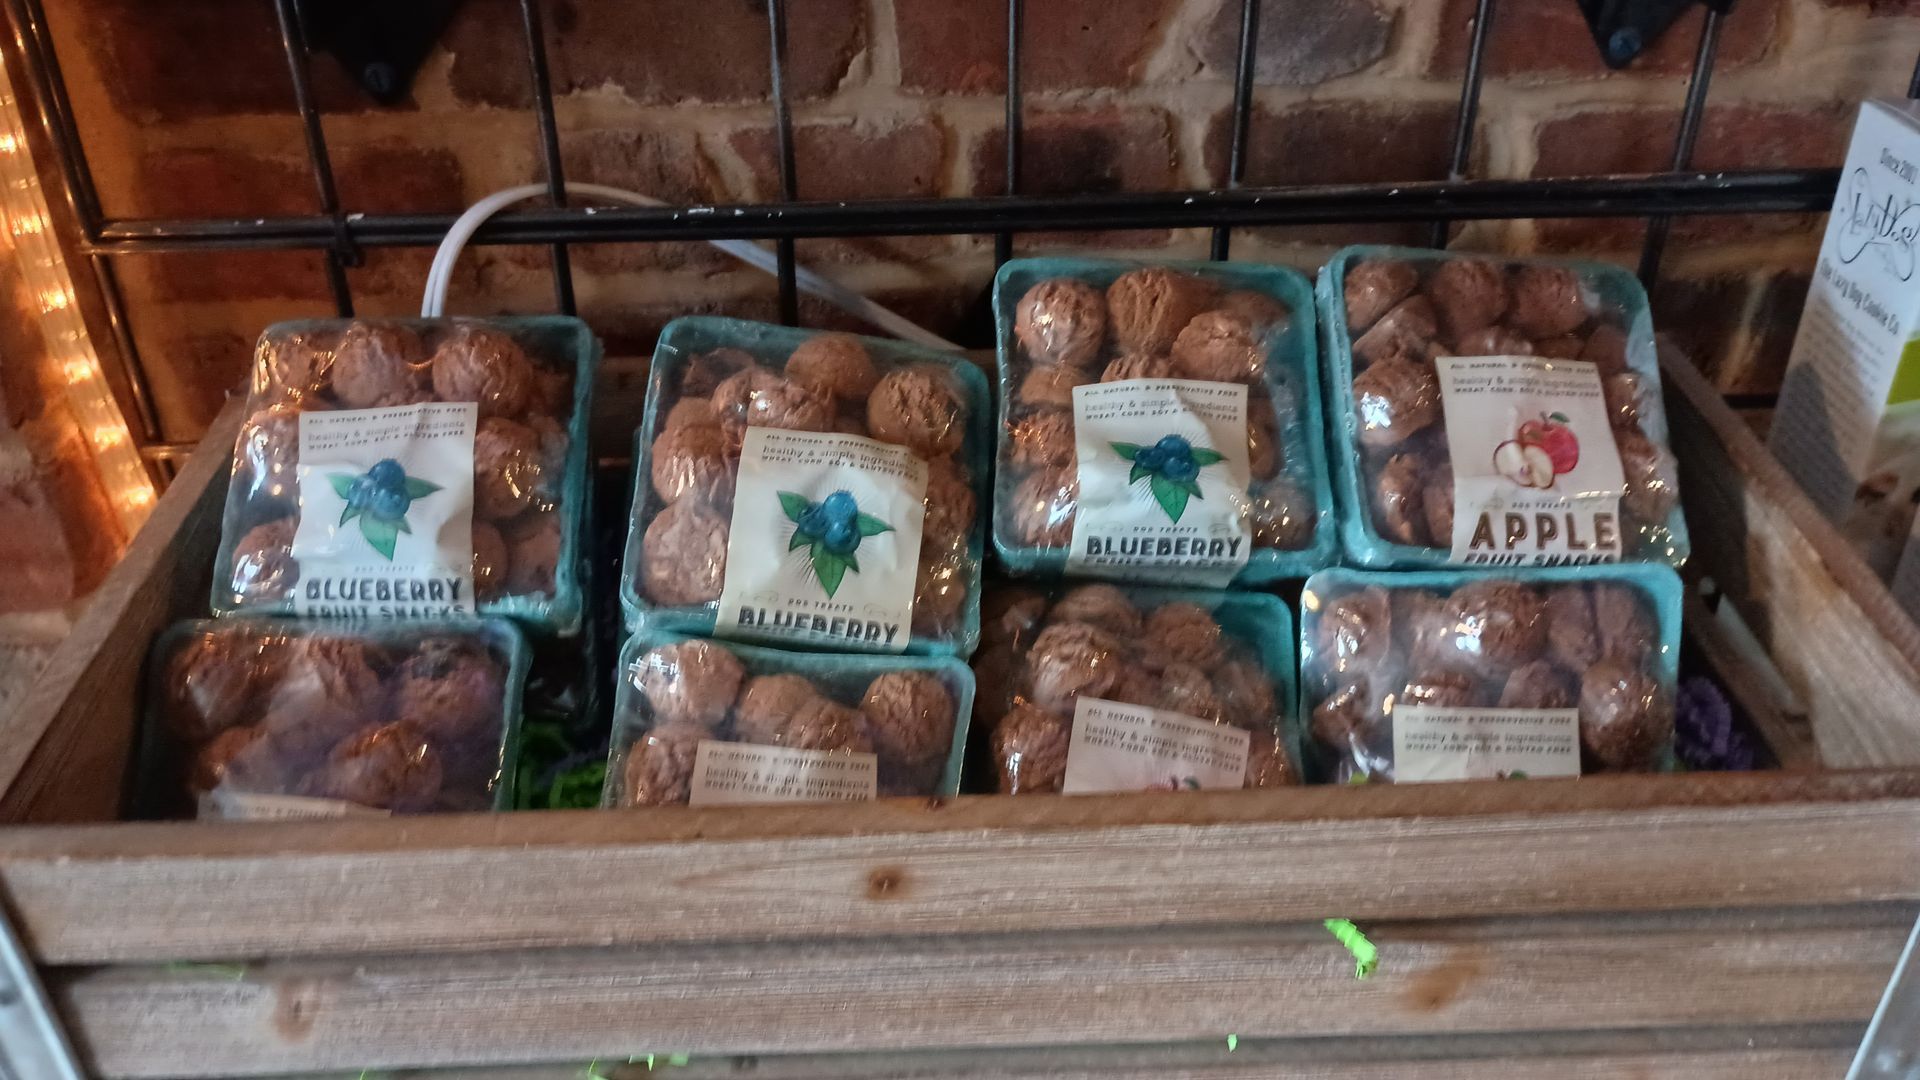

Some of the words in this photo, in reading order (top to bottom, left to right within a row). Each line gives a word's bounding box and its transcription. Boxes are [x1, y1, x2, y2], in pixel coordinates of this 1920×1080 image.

[1521, 363, 1573, 372] PRESEATIVE
[1469, 512, 1616, 550] APPLE
[1087, 536, 1242, 557] BLUEBERRY
[1464, 554, 1527, 565] FRUIT
[1533, 553, 1615, 567] SNACKS
[306, 578, 463, 600] BLUEBERRY
[306, 605, 369, 618] FRUIT
[815, 602, 853, 612] TREATS
[738, 605, 899, 643] BLUEBERRY
